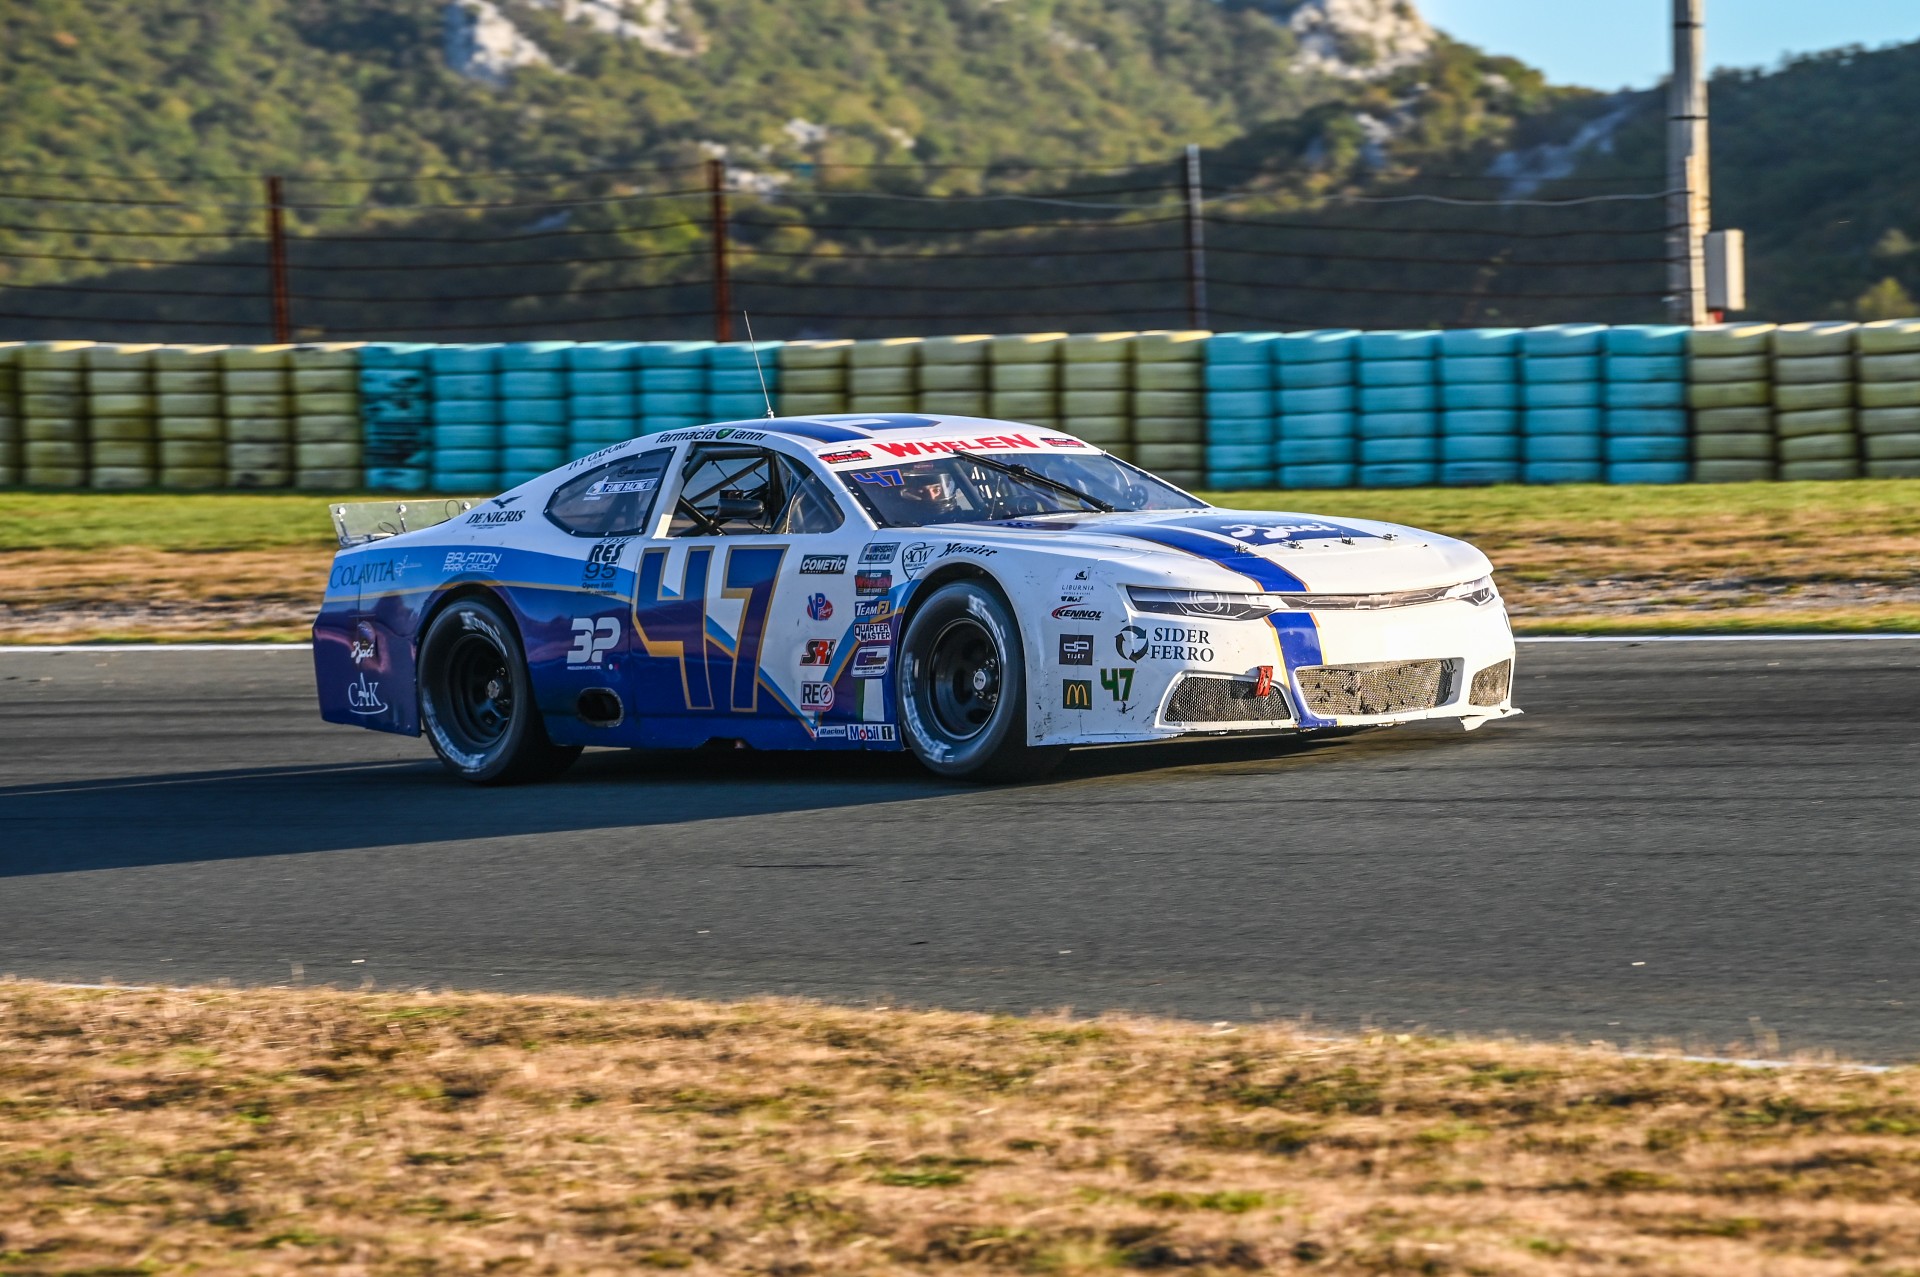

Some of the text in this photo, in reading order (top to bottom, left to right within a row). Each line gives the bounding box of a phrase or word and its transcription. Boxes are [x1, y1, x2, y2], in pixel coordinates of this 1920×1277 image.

[656, 429, 716, 443] farmacia
[871, 434, 1041, 457] WHELEN
[851, 469, 904, 487] 47
[465, 510, 526, 524] DE NIGRIS
[445, 552, 502, 564] BALATON
[588, 544, 625, 562] RES
[937, 543, 997, 558] Hoosier
[442, 563, 464, 572] PARK
[585, 561, 616, 579] 95
[801, 557, 846, 571] COMETIC
[330, 558, 396, 590] COLAVITA
[808, 592, 826, 621] VP
[1056, 609, 1102, 618] KENNOL
[632, 546, 790, 712] 47
[860, 631, 890, 642] MASTER
[1154, 628, 1211, 644] SIDER
[1151, 645, 1215, 662] FERRO
[1100, 668, 1135, 701] 47
[850, 726, 879, 740] Mobil
